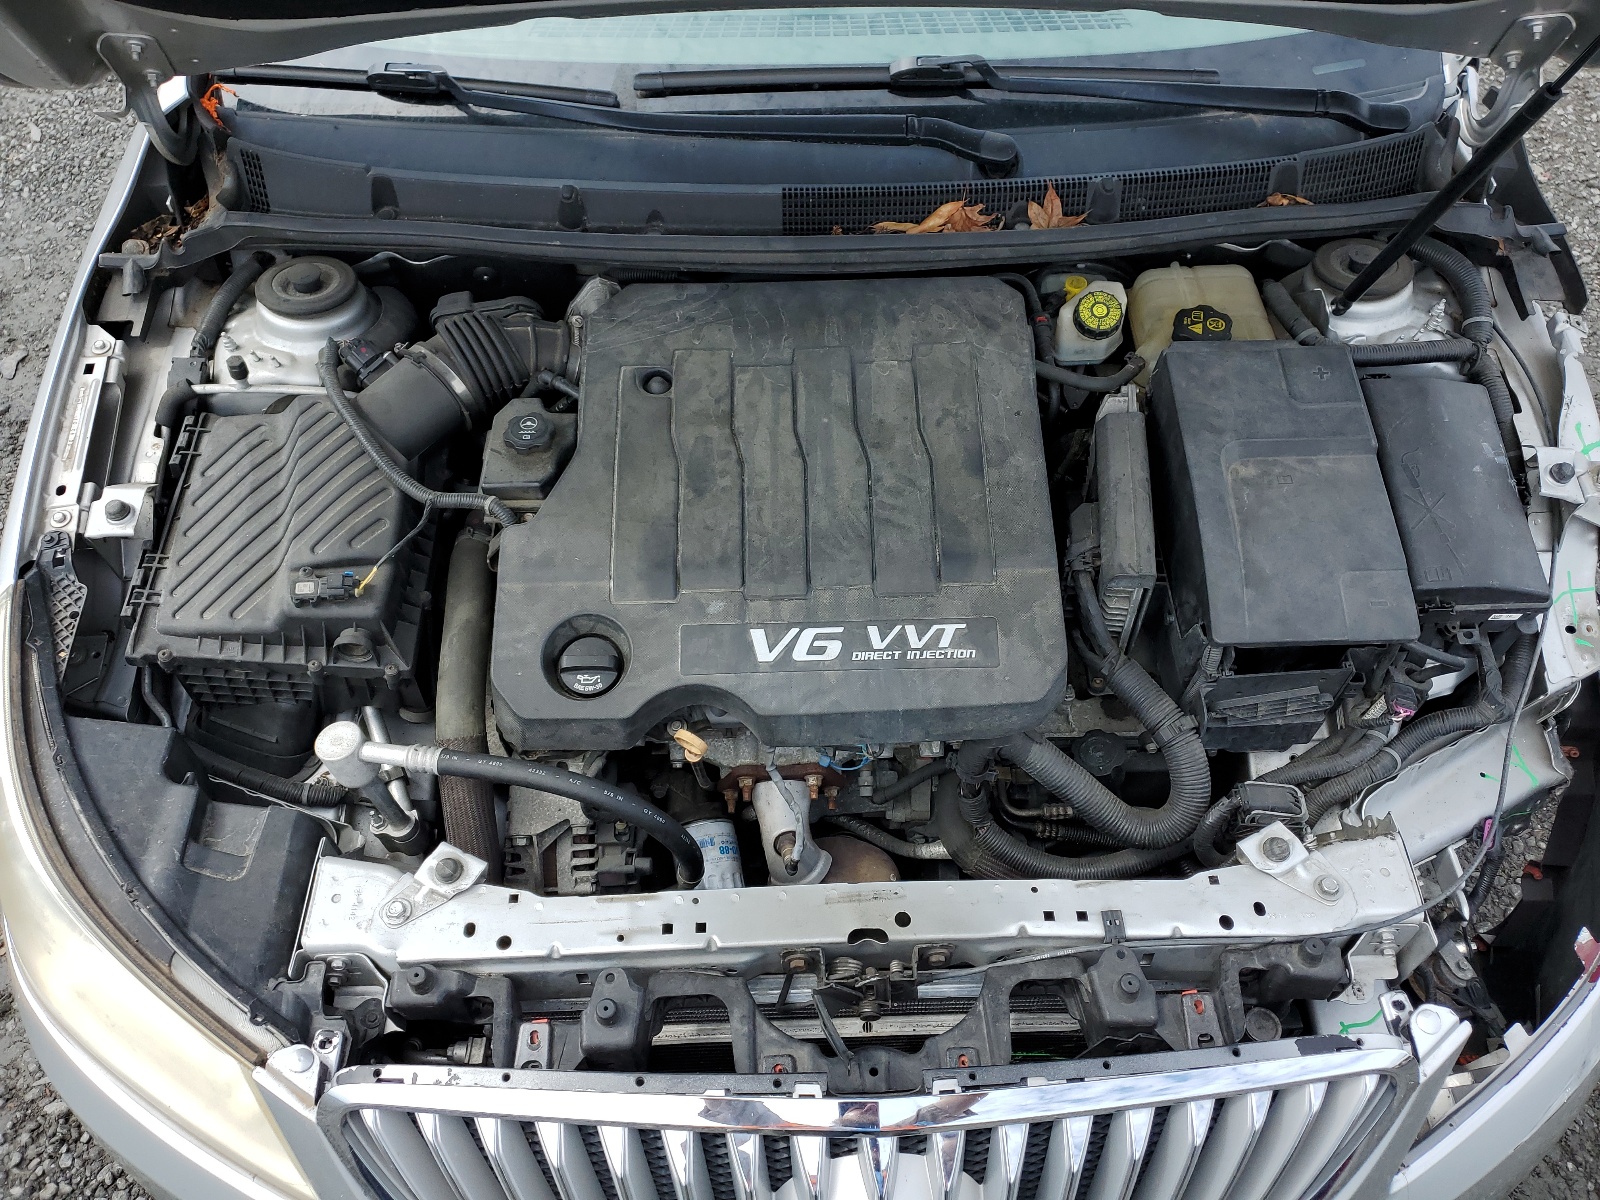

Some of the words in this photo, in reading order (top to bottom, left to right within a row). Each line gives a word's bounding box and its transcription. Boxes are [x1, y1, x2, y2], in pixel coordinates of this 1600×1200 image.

[750, 626, 845, 663] V6
[866, 623, 967, 650] VVT
[851, 650, 902, 661] DIRECT
[906, 648, 976, 660] INJECTION
